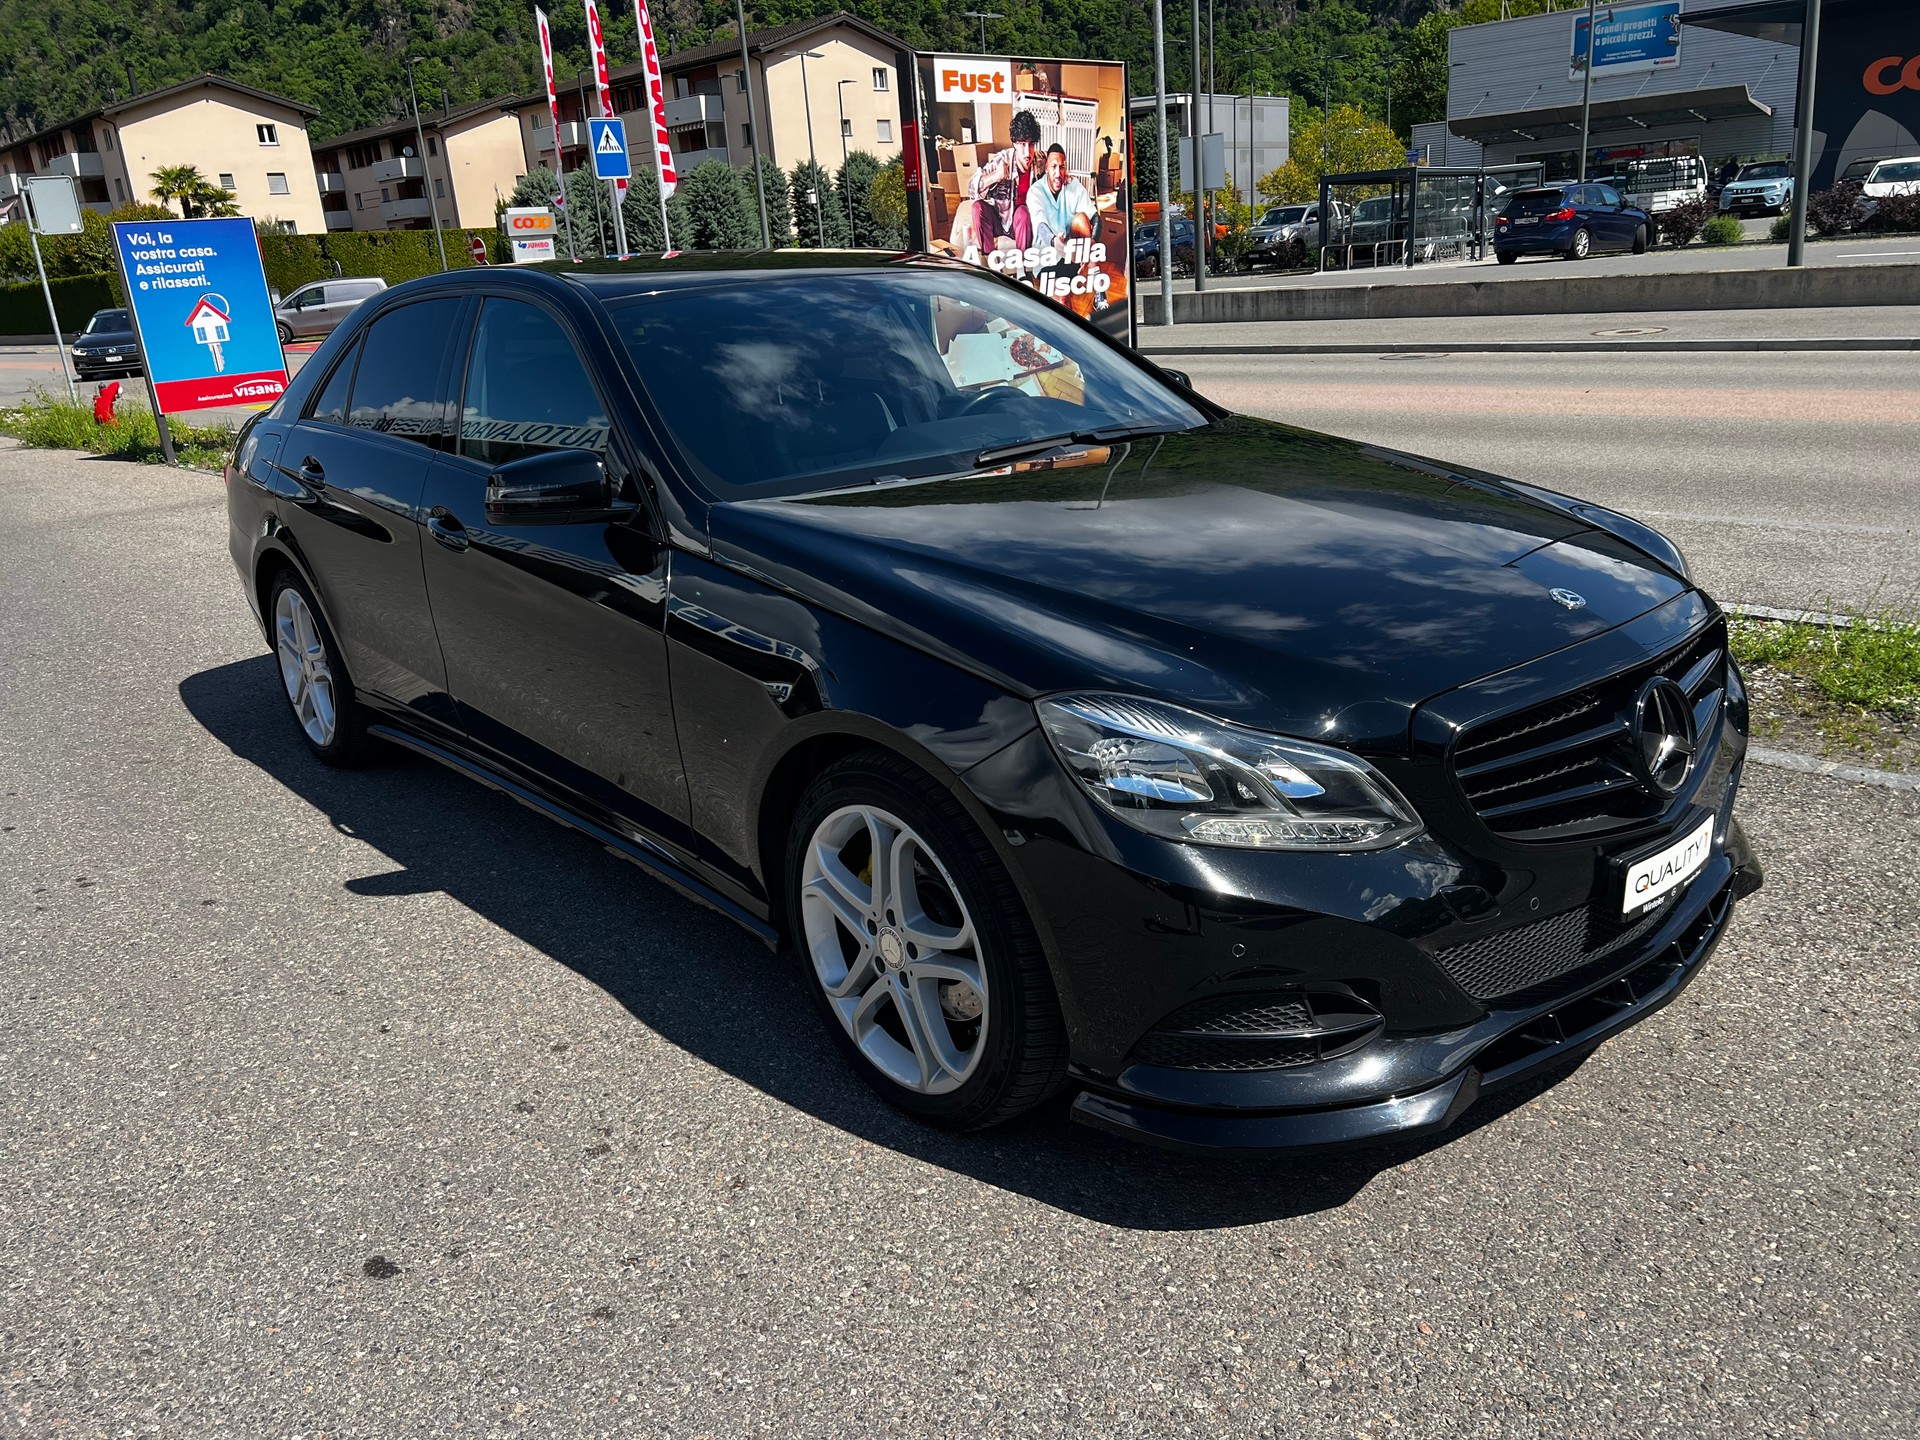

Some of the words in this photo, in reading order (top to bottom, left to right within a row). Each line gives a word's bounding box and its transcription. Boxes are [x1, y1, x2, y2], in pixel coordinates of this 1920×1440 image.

[1594, 23, 1622, 35] Grandi
[1623, 17, 1657, 31] progetti
[1594, 38, 1600, 46] a
[1601, 34, 1627, 46] piccoli
[1628, 28, 1657, 43] prezzi.
[942, 70, 1005, 93] Fust
[513, 216, 552, 231] coop
[126, 232, 156, 247] Voi,
[157, 231, 173, 245] la
[131, 248, 177, 261] vostra
[179, 247, 218, 258] casa.
[962, 245, 981, 266] A
[987, 246, 1058, 271] casa
[1062, 237, 1107, 264] fila
[136, 259, 205, 276] Assicurati
[139, 281, 149, 291] e
[151, 274, 211, 290] rilassati.
[1039, 266, 1111, 297] liscio
